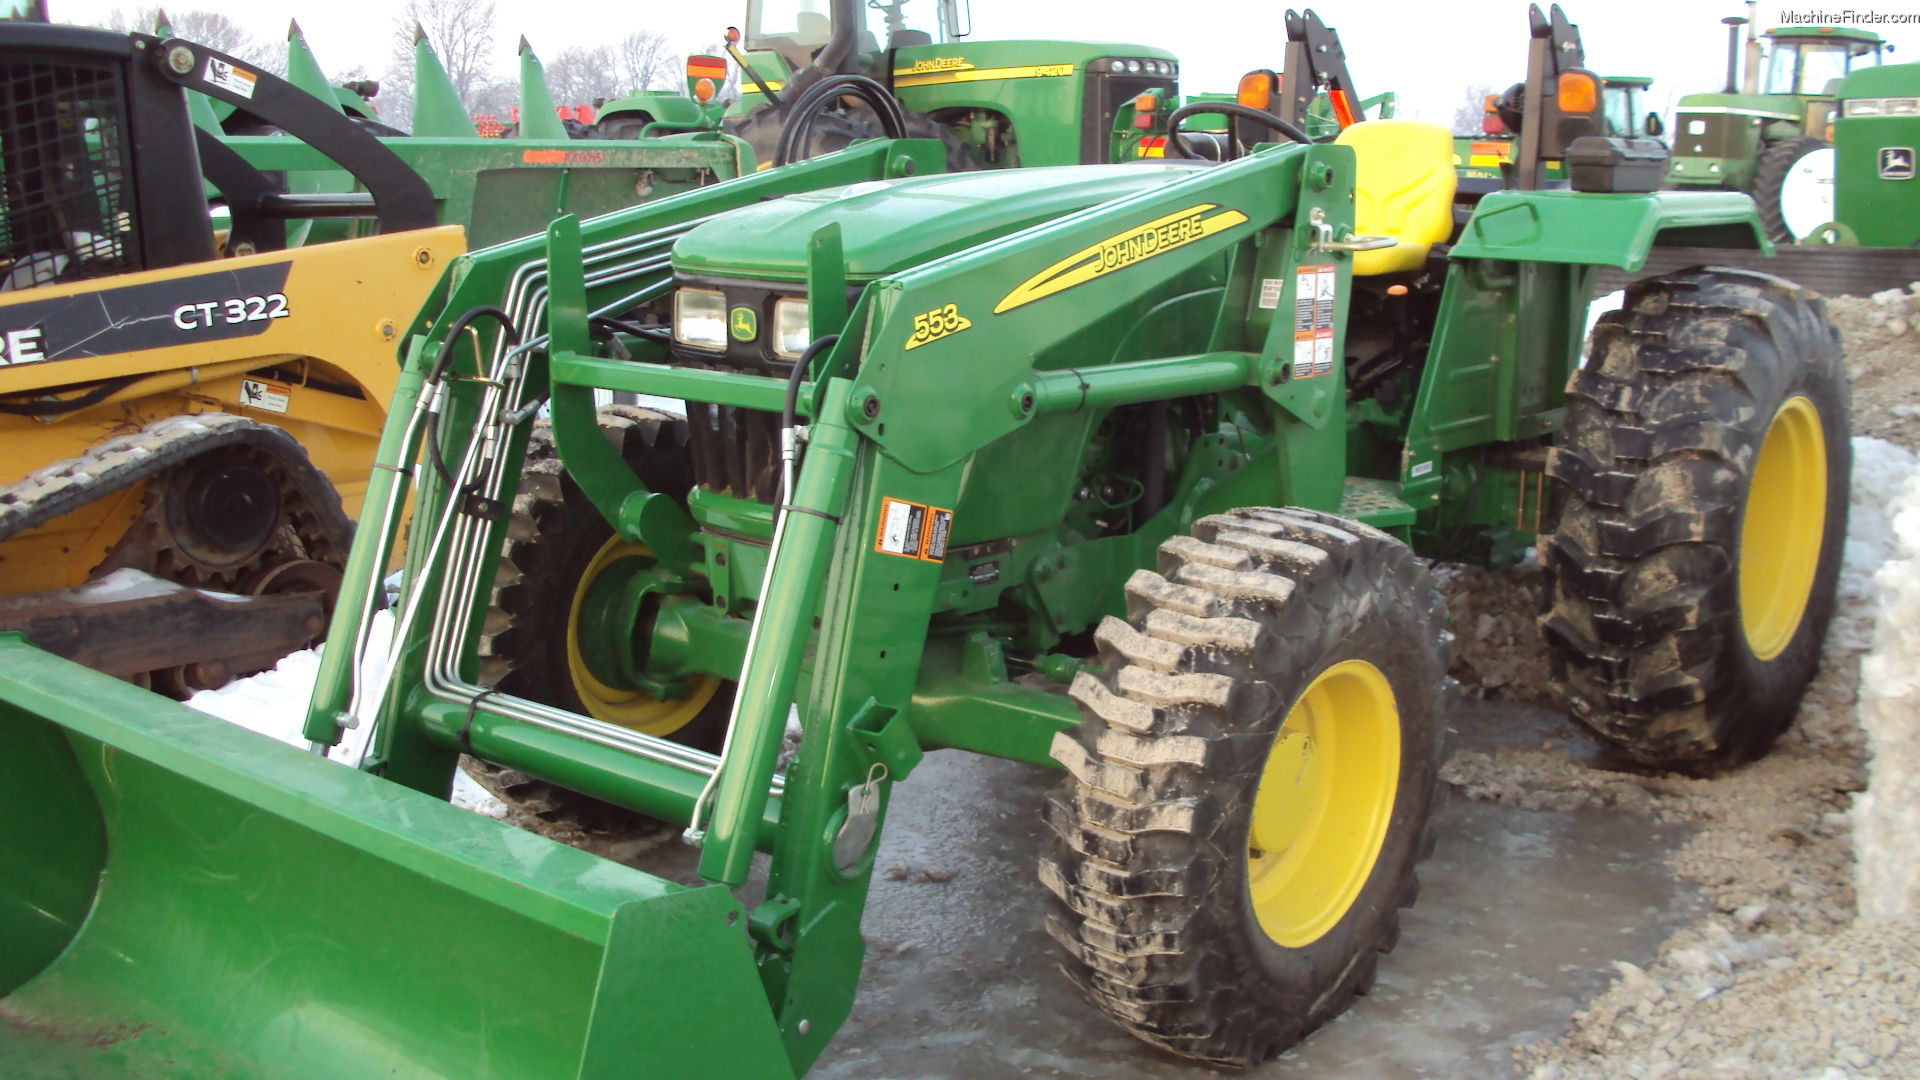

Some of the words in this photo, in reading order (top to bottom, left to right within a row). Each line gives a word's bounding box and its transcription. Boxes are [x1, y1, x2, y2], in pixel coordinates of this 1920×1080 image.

[1095, 236, 1142, 273] JOHN
[1143, 214, 1203, 253] DEERE
[173, 302, 218, 330] CT
[224, 294, 289, 324] 322
[914, 303, 959, 342] 553
